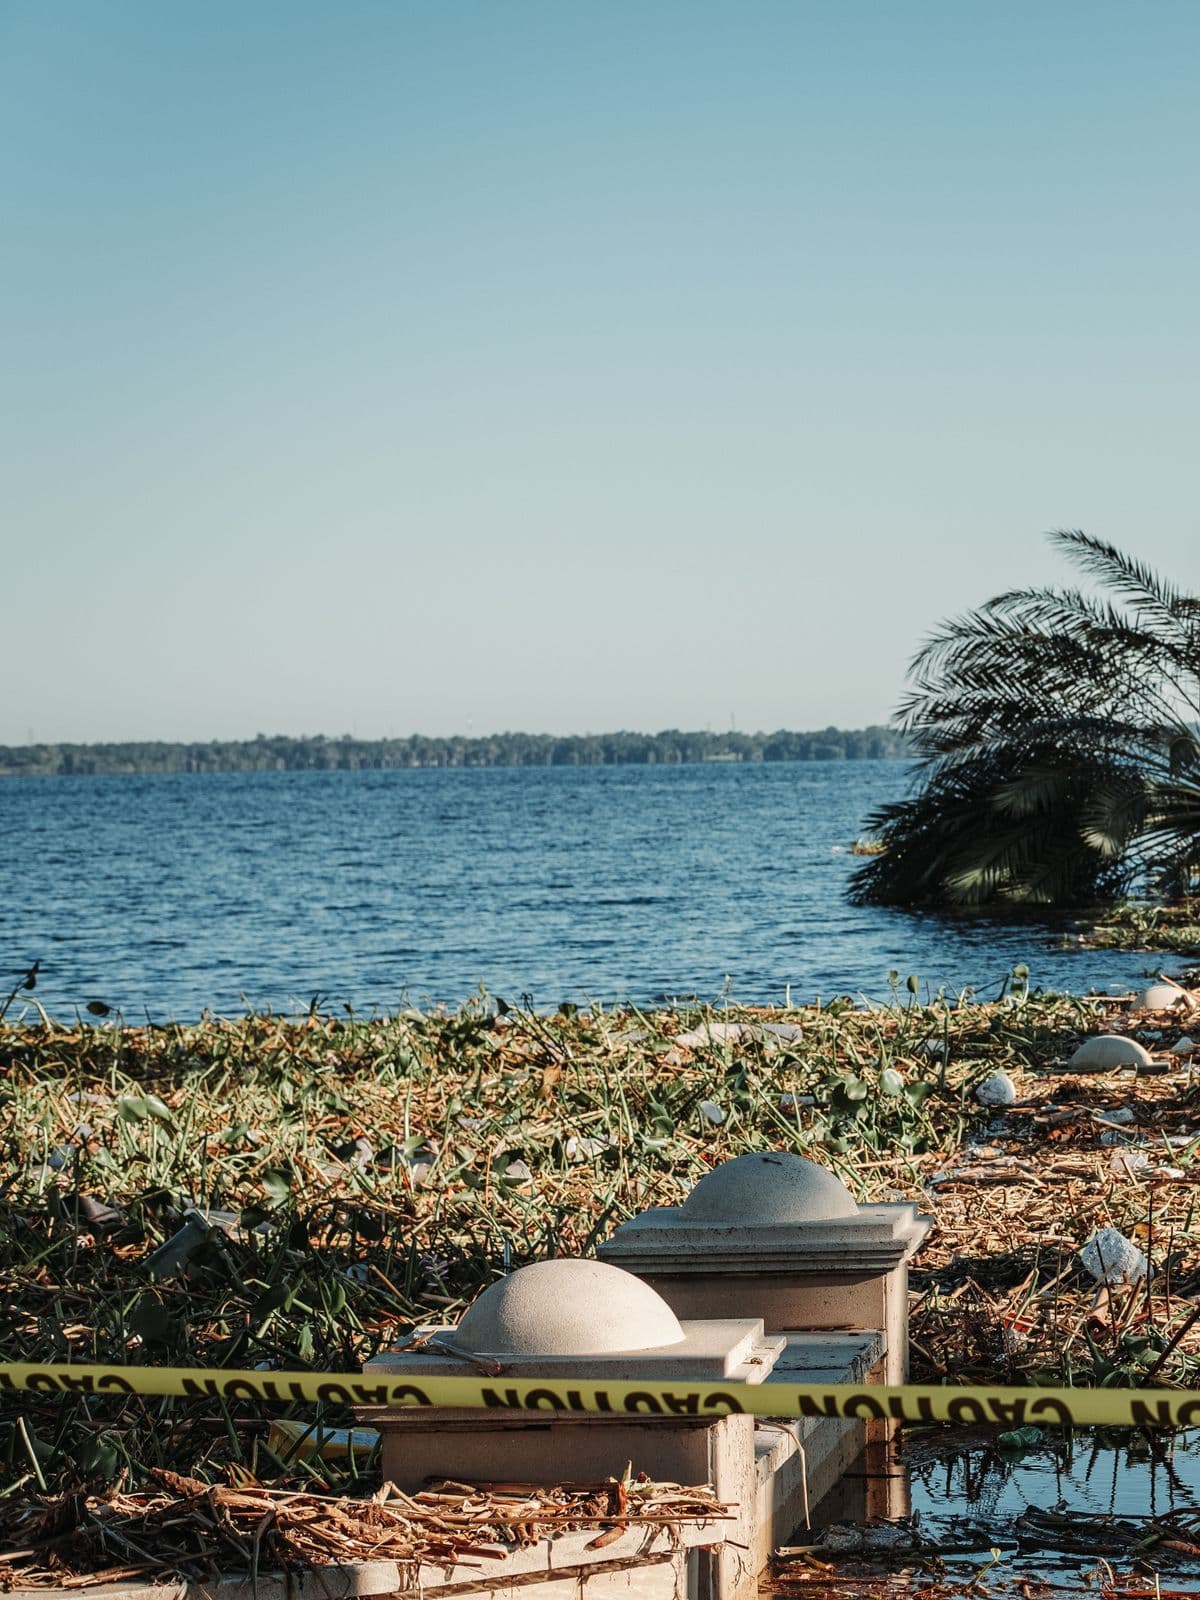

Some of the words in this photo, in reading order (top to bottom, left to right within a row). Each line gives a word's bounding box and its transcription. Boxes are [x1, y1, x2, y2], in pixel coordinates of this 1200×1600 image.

[182, 1377, 433, 1405] CAUTION
[481, 1387, 744, 1413] CAUTION
[798, 1393, 1074, 1424] CAUTION
